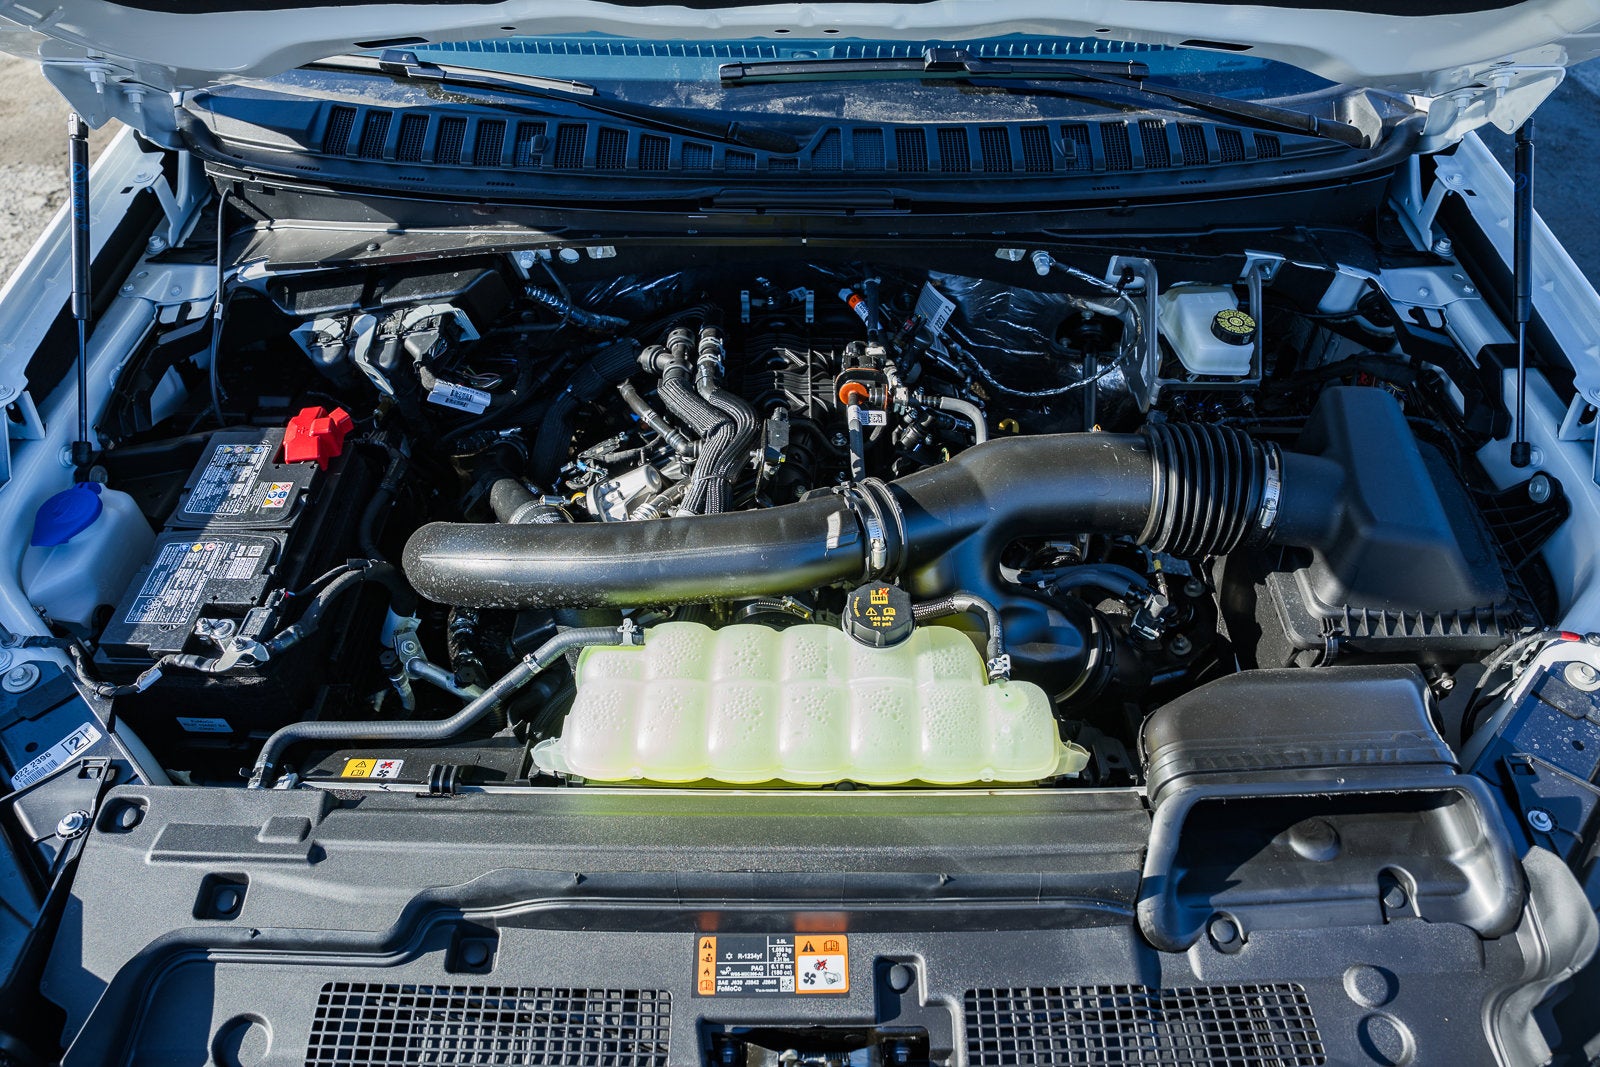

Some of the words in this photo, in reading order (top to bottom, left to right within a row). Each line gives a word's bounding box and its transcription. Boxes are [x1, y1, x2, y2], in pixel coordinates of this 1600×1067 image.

[68, 736, 84, 751] 2
[14, 766, 30, 781] 022
[31, 751, 52, 768] 2396
